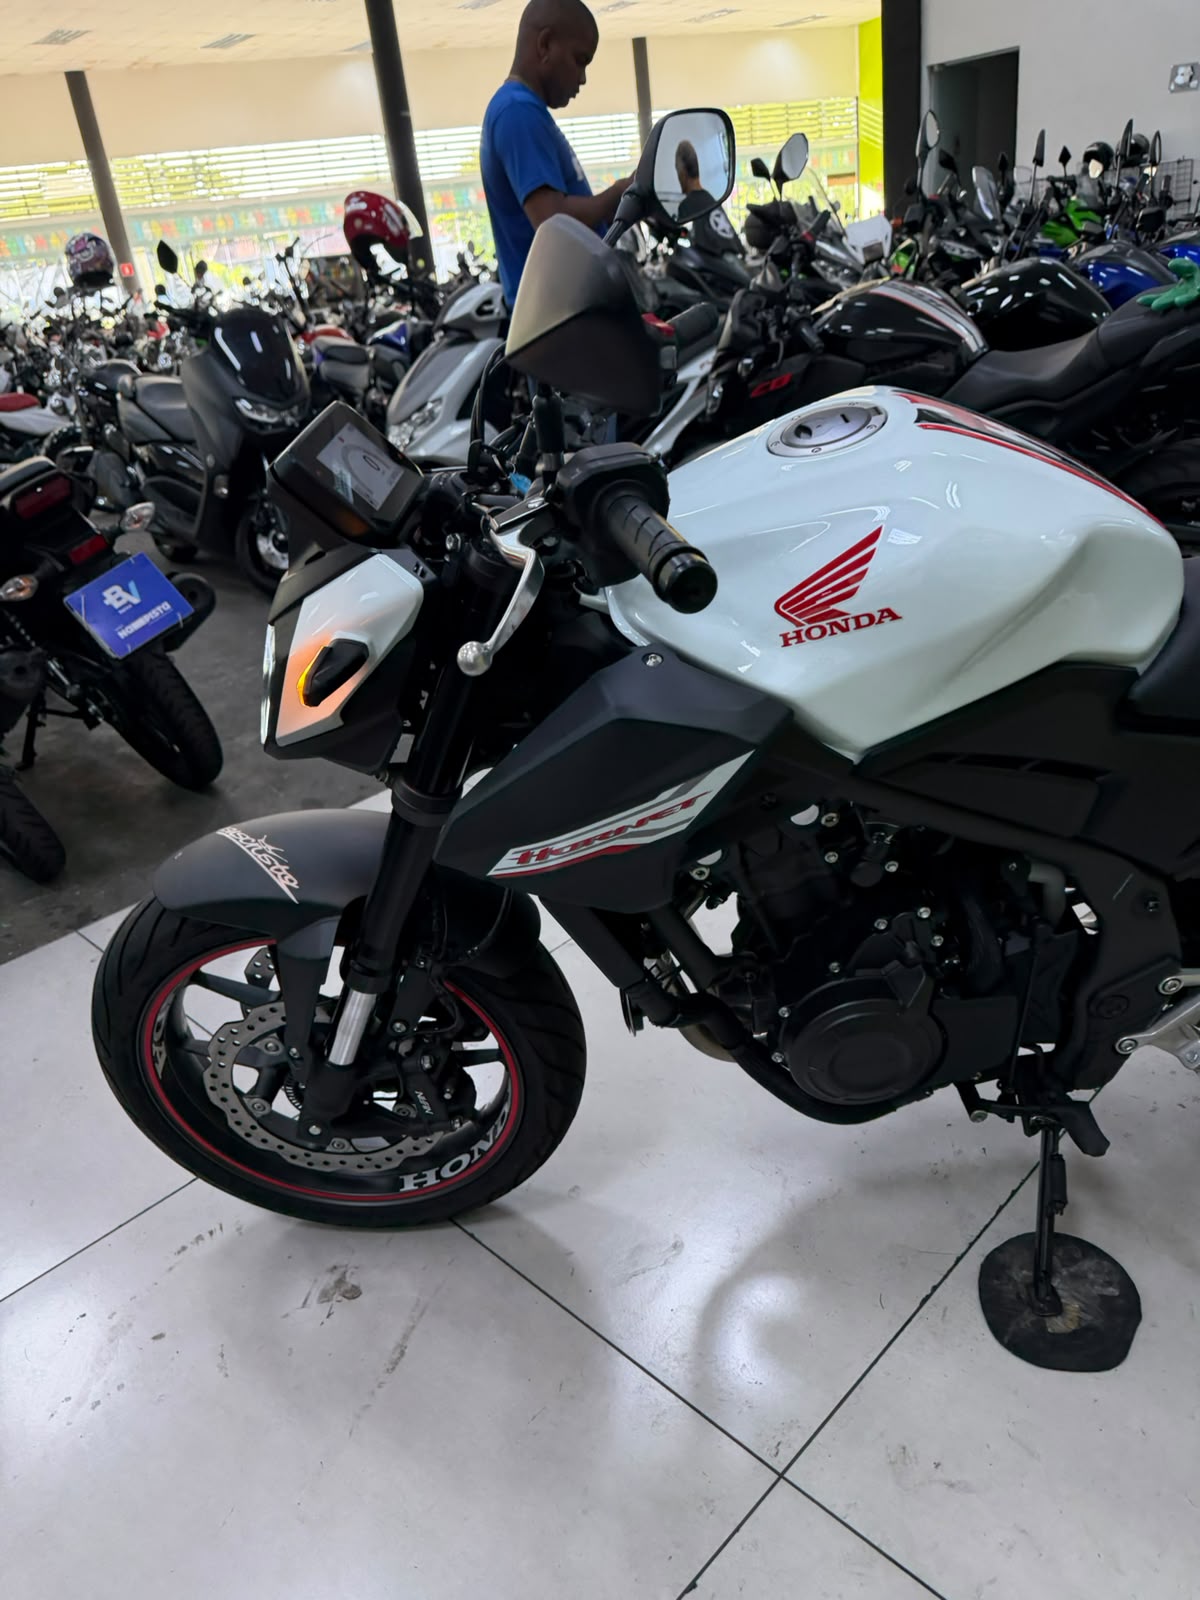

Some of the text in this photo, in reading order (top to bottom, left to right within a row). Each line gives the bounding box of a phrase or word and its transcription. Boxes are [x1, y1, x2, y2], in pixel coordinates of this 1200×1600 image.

[102, 580, 142, 610] BV
[780, 606, 903, 648] HONDA
[507, 791, 713, 865] HORNET
